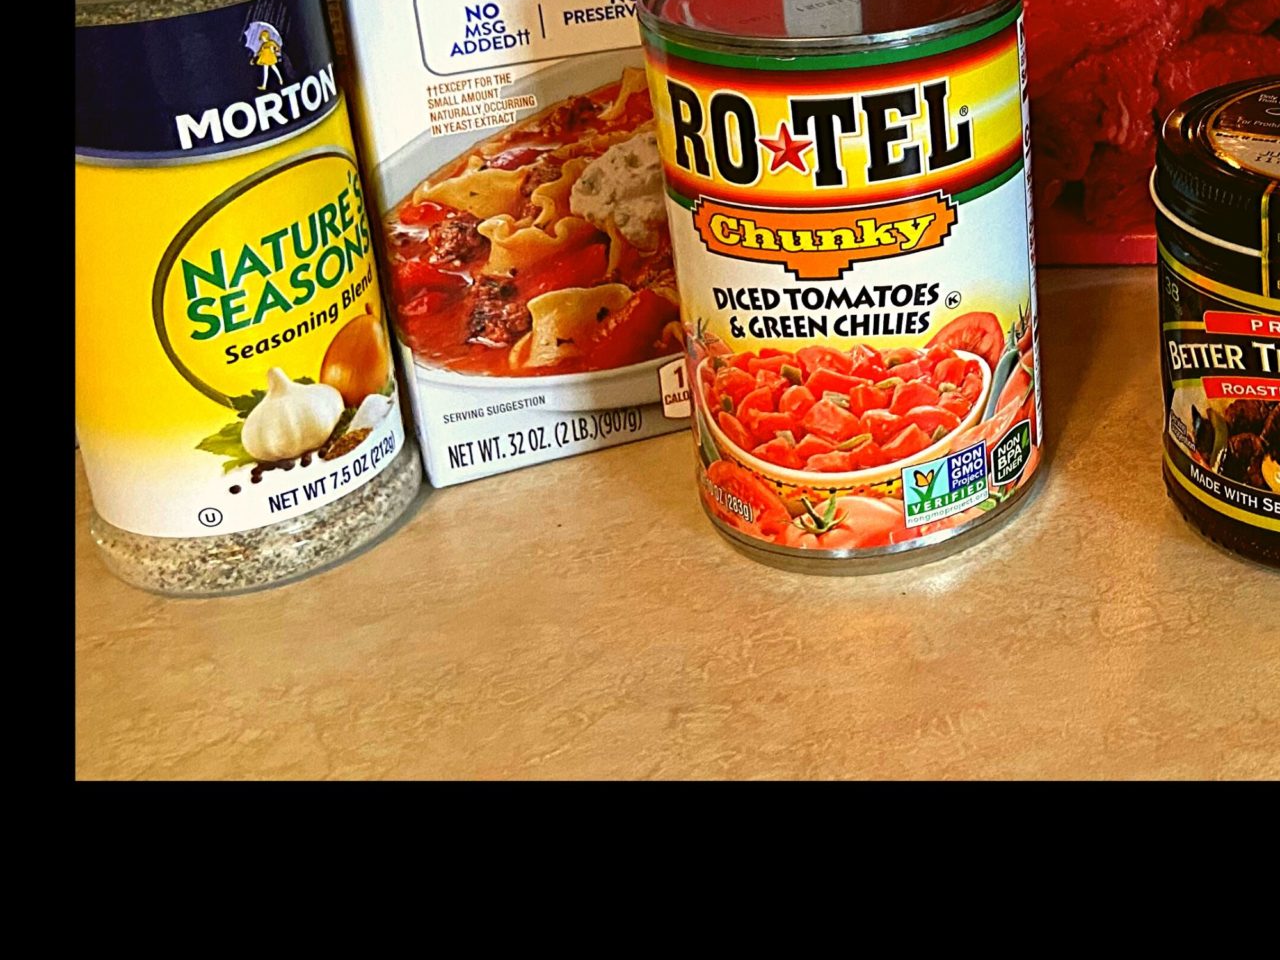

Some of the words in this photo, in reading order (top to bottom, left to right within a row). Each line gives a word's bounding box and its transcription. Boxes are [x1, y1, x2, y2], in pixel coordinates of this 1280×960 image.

[465, 2, 499, 22] NO
[464, 19, 506, 39] MSG
[475, 75, 493, 88] FOR
[494, 73, 512, 85] THE
[175, 63, 338, 150] MORTON
[428, 95, 461, 110] SMALL
[461, 88, 499, 103] AMOUNT
[483, 95, 535, 113] OCCURRING
[431, 124, 442, 135] IN
[443, 119, 474, 133] YEAST
[475, 112, 515, 128] EXTRACT
[181, 170, 363, 300] NATURE'S
[709, 211, 936, 252] Chunky
[186, 213, 370, 341] SEASONS
[713, 286, 780, 312] DICED
[781, 282, 940, 310] TOMATOES
[224, 301, 340, 365] Seasoning
[342, 263, 373, 312] Blend
[730, 316, 746, 339] &
[749, 315, 829, 339] GREEN
[833, 311, 930, 337] CHILIES
[1168, 341, 1247, 371] BETTER
[443, 406, 485, 424] SERVING
[486, 395, 546, 416] SUGGESTION
[448, 441, 474, 470] NET
[478, 435, 507, 463] WT.
[507, 431, 525, 457] 32
[528, 427, 552, 453] OZ.
[554, 420, 569, 450] (2
[951, 446, 982, 468] NON
[997, 432, 1021, 458] NON
[997, 444, 1023, 470] BPA
[268, 488, 300, 513] NET
[302, 478, 327, 504] WT
[329, 465, 352, 491] 7.5
[352, 455, 369, 478] OZ
[370, 430, 396, 471] (212g)
[951, 458, 984, 480] GMO
[951, 469, 984, 490] Project
[997, 454, 1023, 480] LINER
[911, 480, 985, 514] VERIFIED
[1190, 463, 1222, 496] MADE
[1223, 487, 1259, 510] WITH
